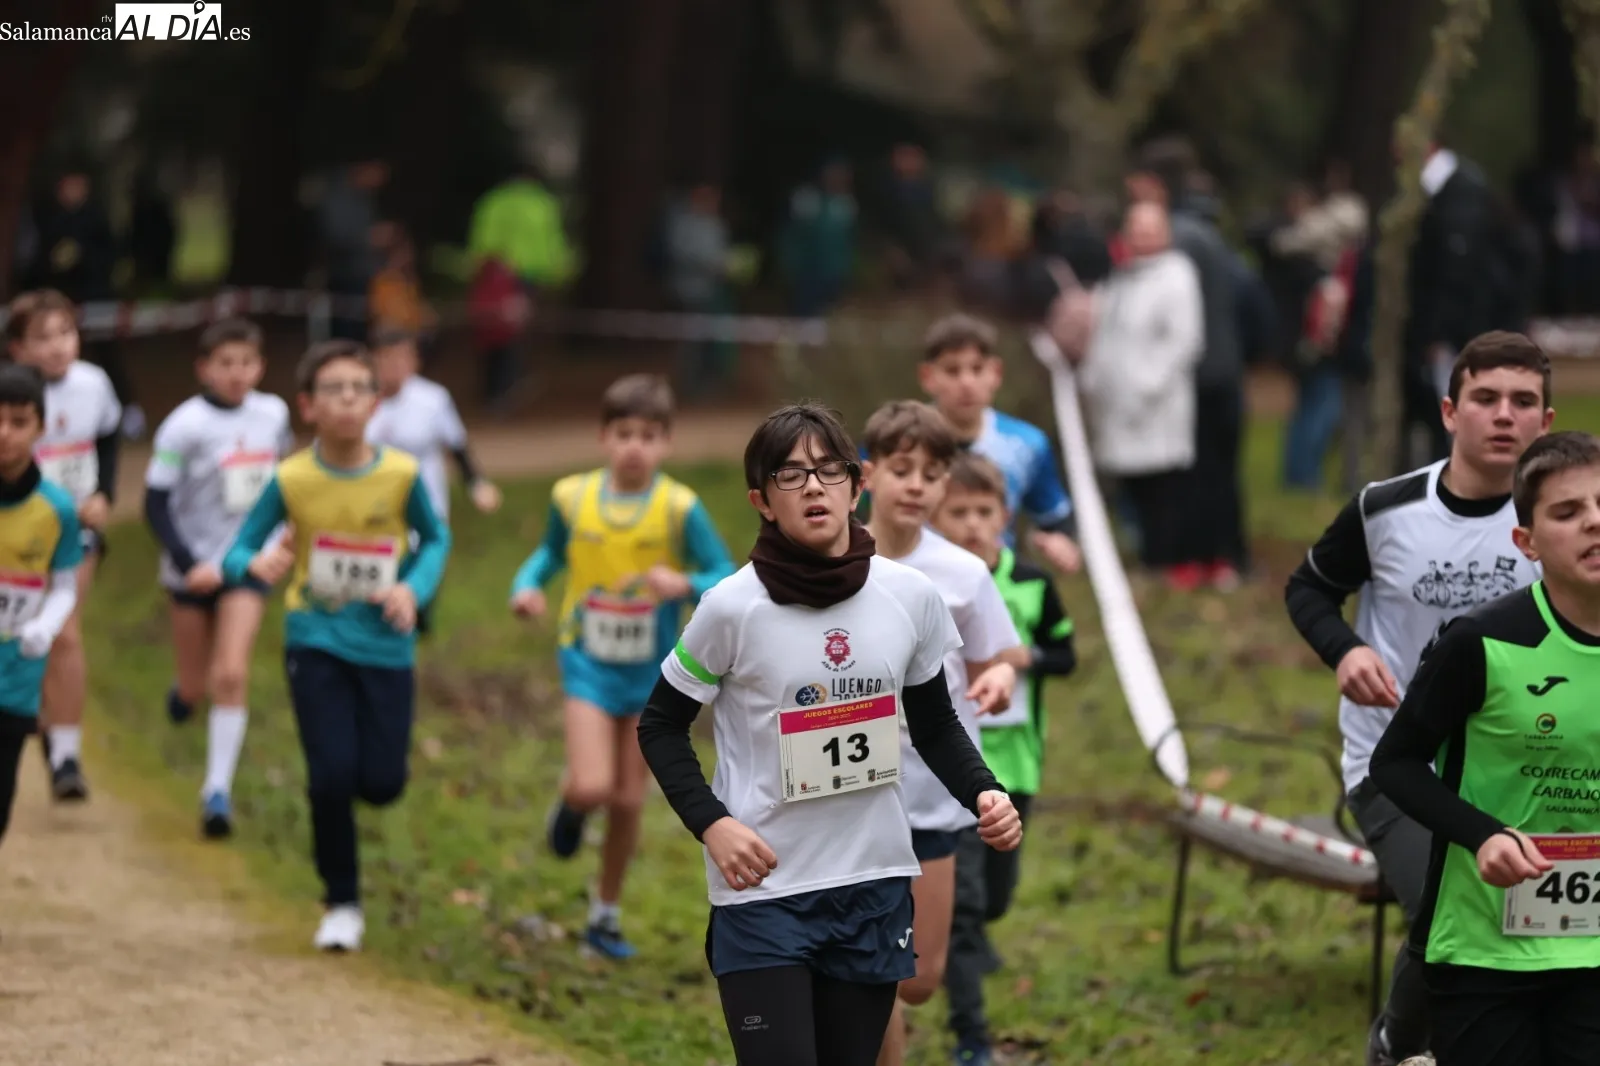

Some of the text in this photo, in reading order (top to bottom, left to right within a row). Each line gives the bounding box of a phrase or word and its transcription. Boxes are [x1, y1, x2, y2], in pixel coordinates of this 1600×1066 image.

[832, 678, 882, 697] LUENGO
[803, 702, 873, 719] JUEGOS ESCOLARES
[822, 732, 870, 767] 13
